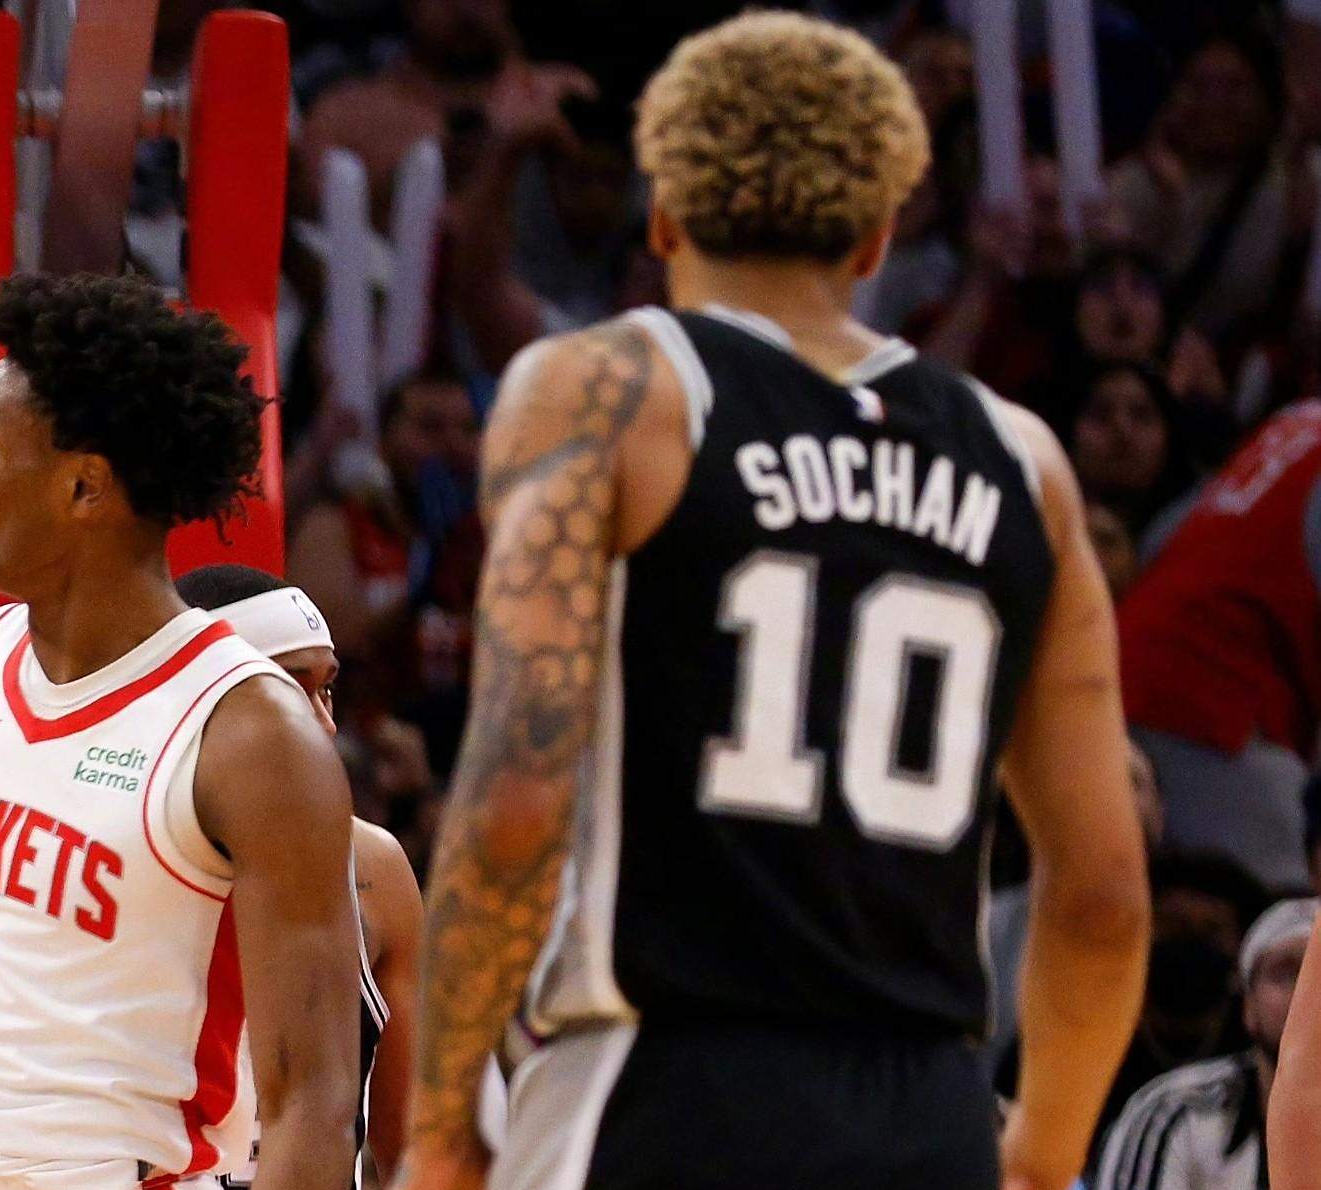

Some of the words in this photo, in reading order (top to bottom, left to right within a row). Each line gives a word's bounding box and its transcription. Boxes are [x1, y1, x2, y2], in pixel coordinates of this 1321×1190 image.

[734, 433, 1002, 567] SOCHAN
[696, 547, 1005, 855] 10
[72, 761, 140, 792] karma
[86, 745, 149, 771] credit
